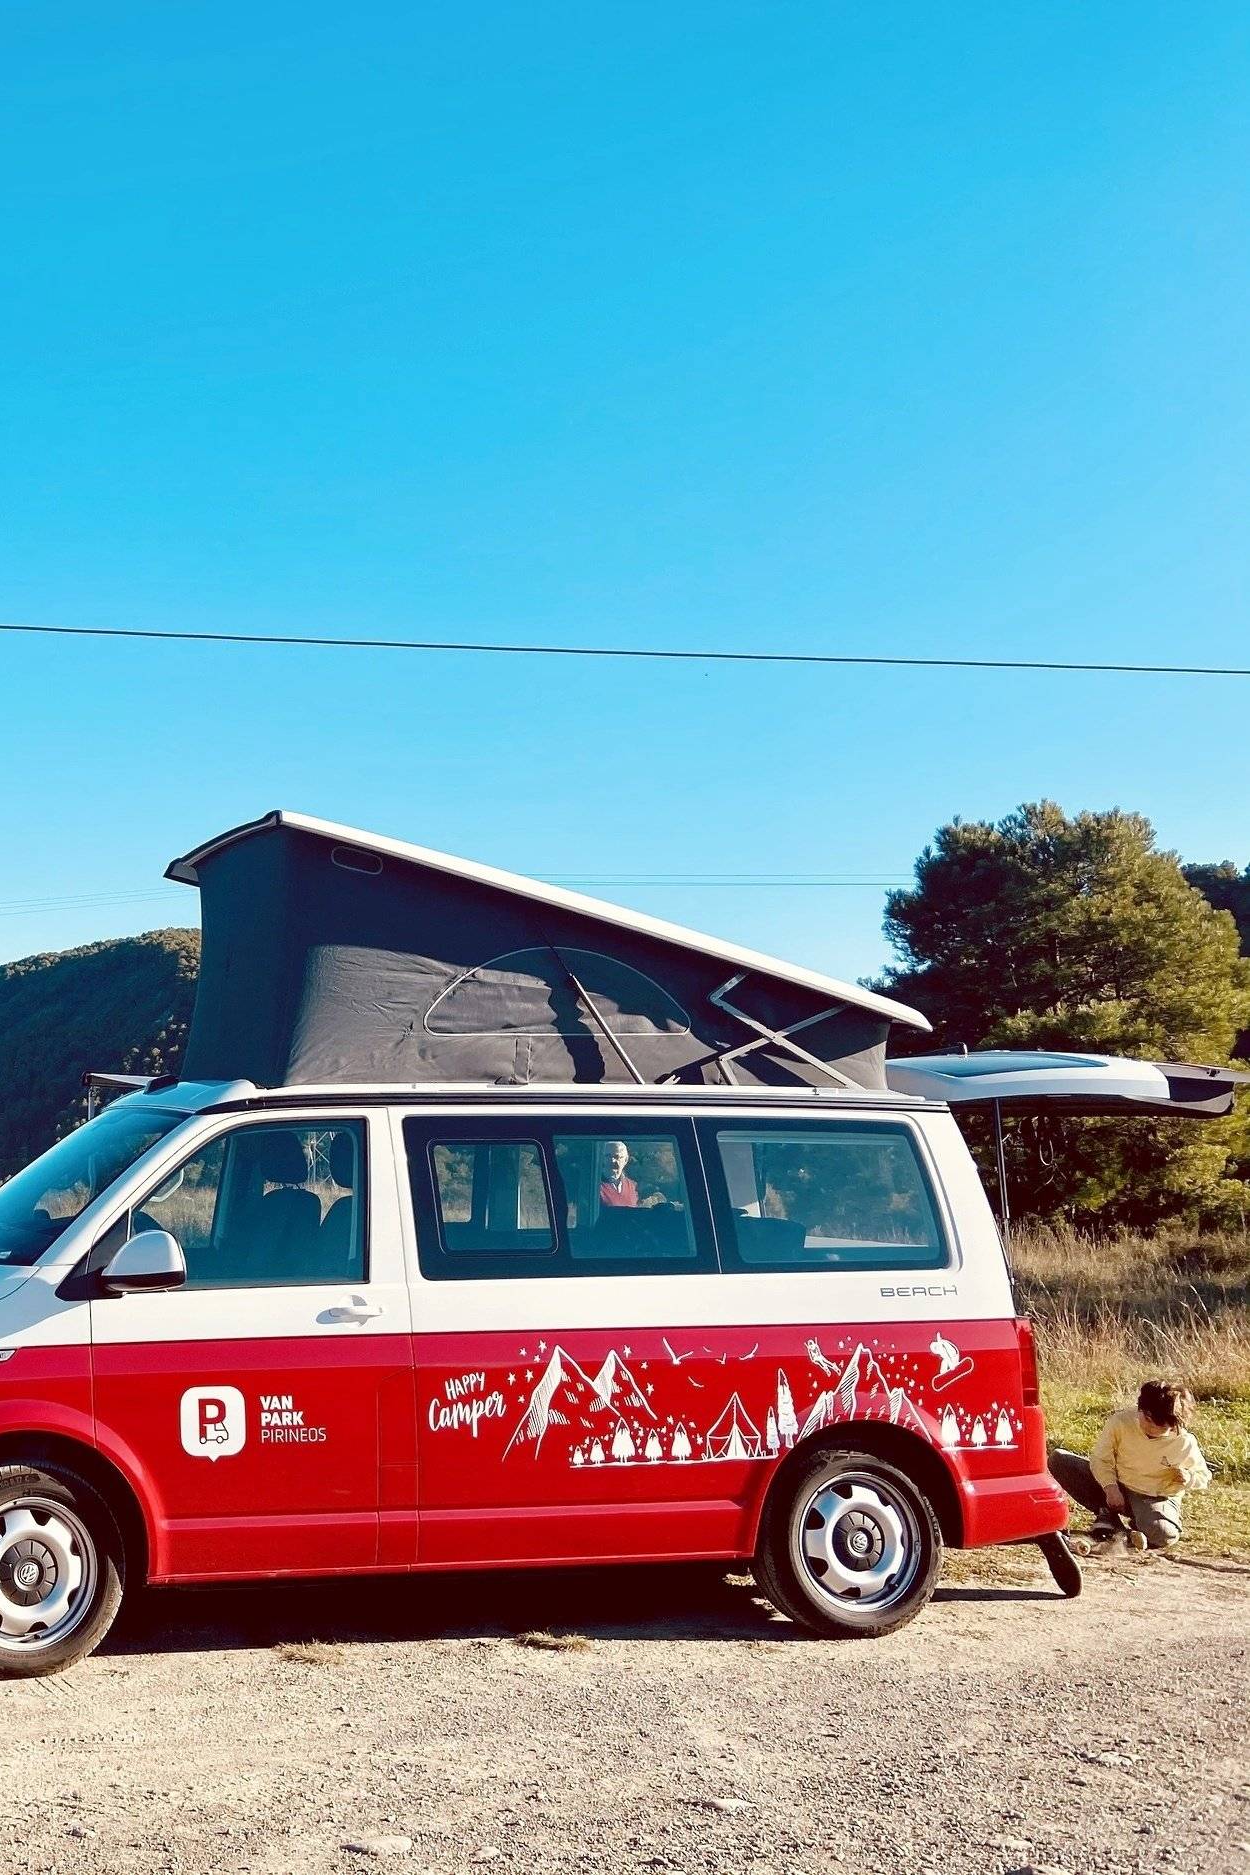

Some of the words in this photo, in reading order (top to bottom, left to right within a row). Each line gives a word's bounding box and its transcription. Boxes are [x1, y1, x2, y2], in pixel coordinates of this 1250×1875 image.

[880, 1285, 958, 1297] BEACH
[444, 1371, 486, 1400] HAPPY
[259, 1395, 293, 1410] VAN
[260, 1411, 305, 1427] PARK
[428, 1390, 507, 1438] Camper
[260, 1427, 327, 1443] PIRINEOS
